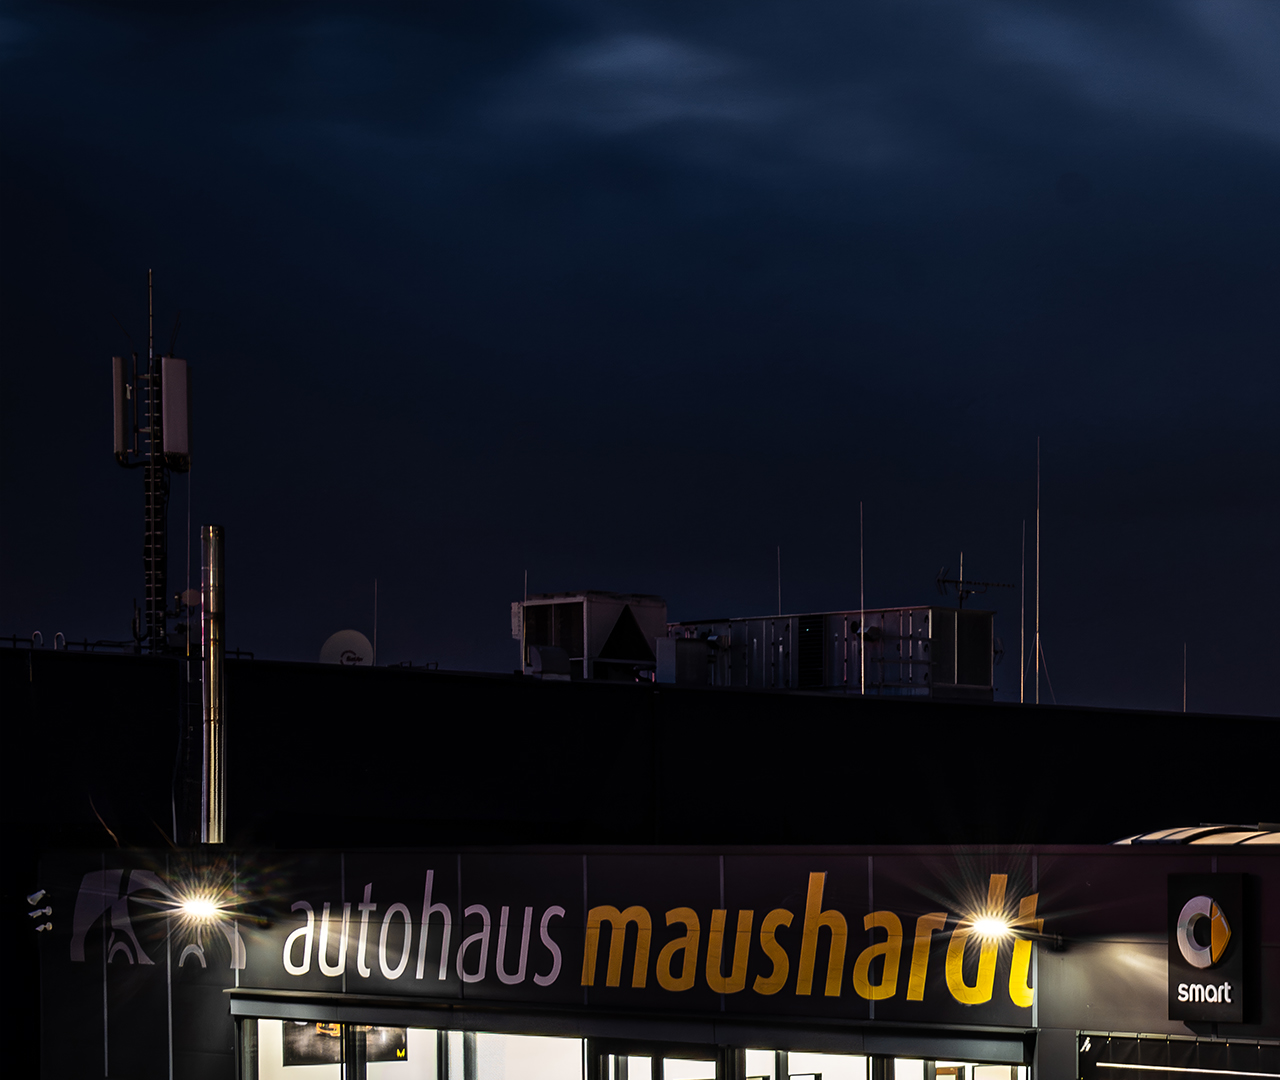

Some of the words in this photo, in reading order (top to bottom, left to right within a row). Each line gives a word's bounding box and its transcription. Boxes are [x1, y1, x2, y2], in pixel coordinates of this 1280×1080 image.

[282, 869, 566, 987] autohaus
[580, 872, 1044, 1008] maushardt
[1177, 982, 1232, 1003] smart
